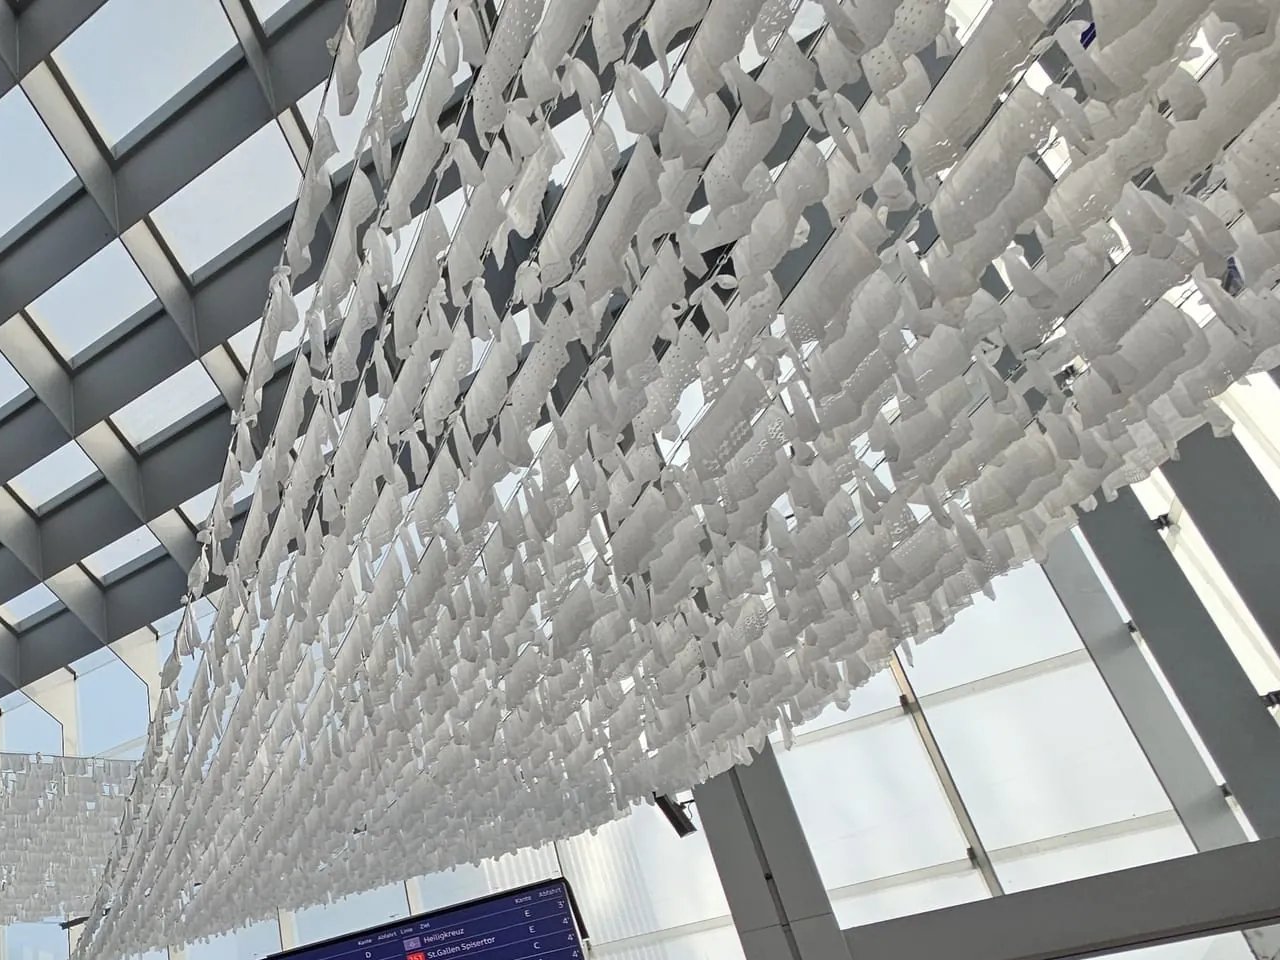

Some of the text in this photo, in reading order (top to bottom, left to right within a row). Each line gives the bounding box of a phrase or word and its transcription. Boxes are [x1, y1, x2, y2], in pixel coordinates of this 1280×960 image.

[514, 895, 531, 904] Kante
[537, 886, 561, 898] Abfahrt
[423, 928, 464, 943] Heiligkreuz
[524, 909, 531, 917] E
[377, 930, 397, 941] Abfahrt
[427, 946, 461, 960] St.Gallen
[461, 937, 496, 951] Spisertor
[528, 925, 536, 934] E
[533, 941, 541, 950] C
